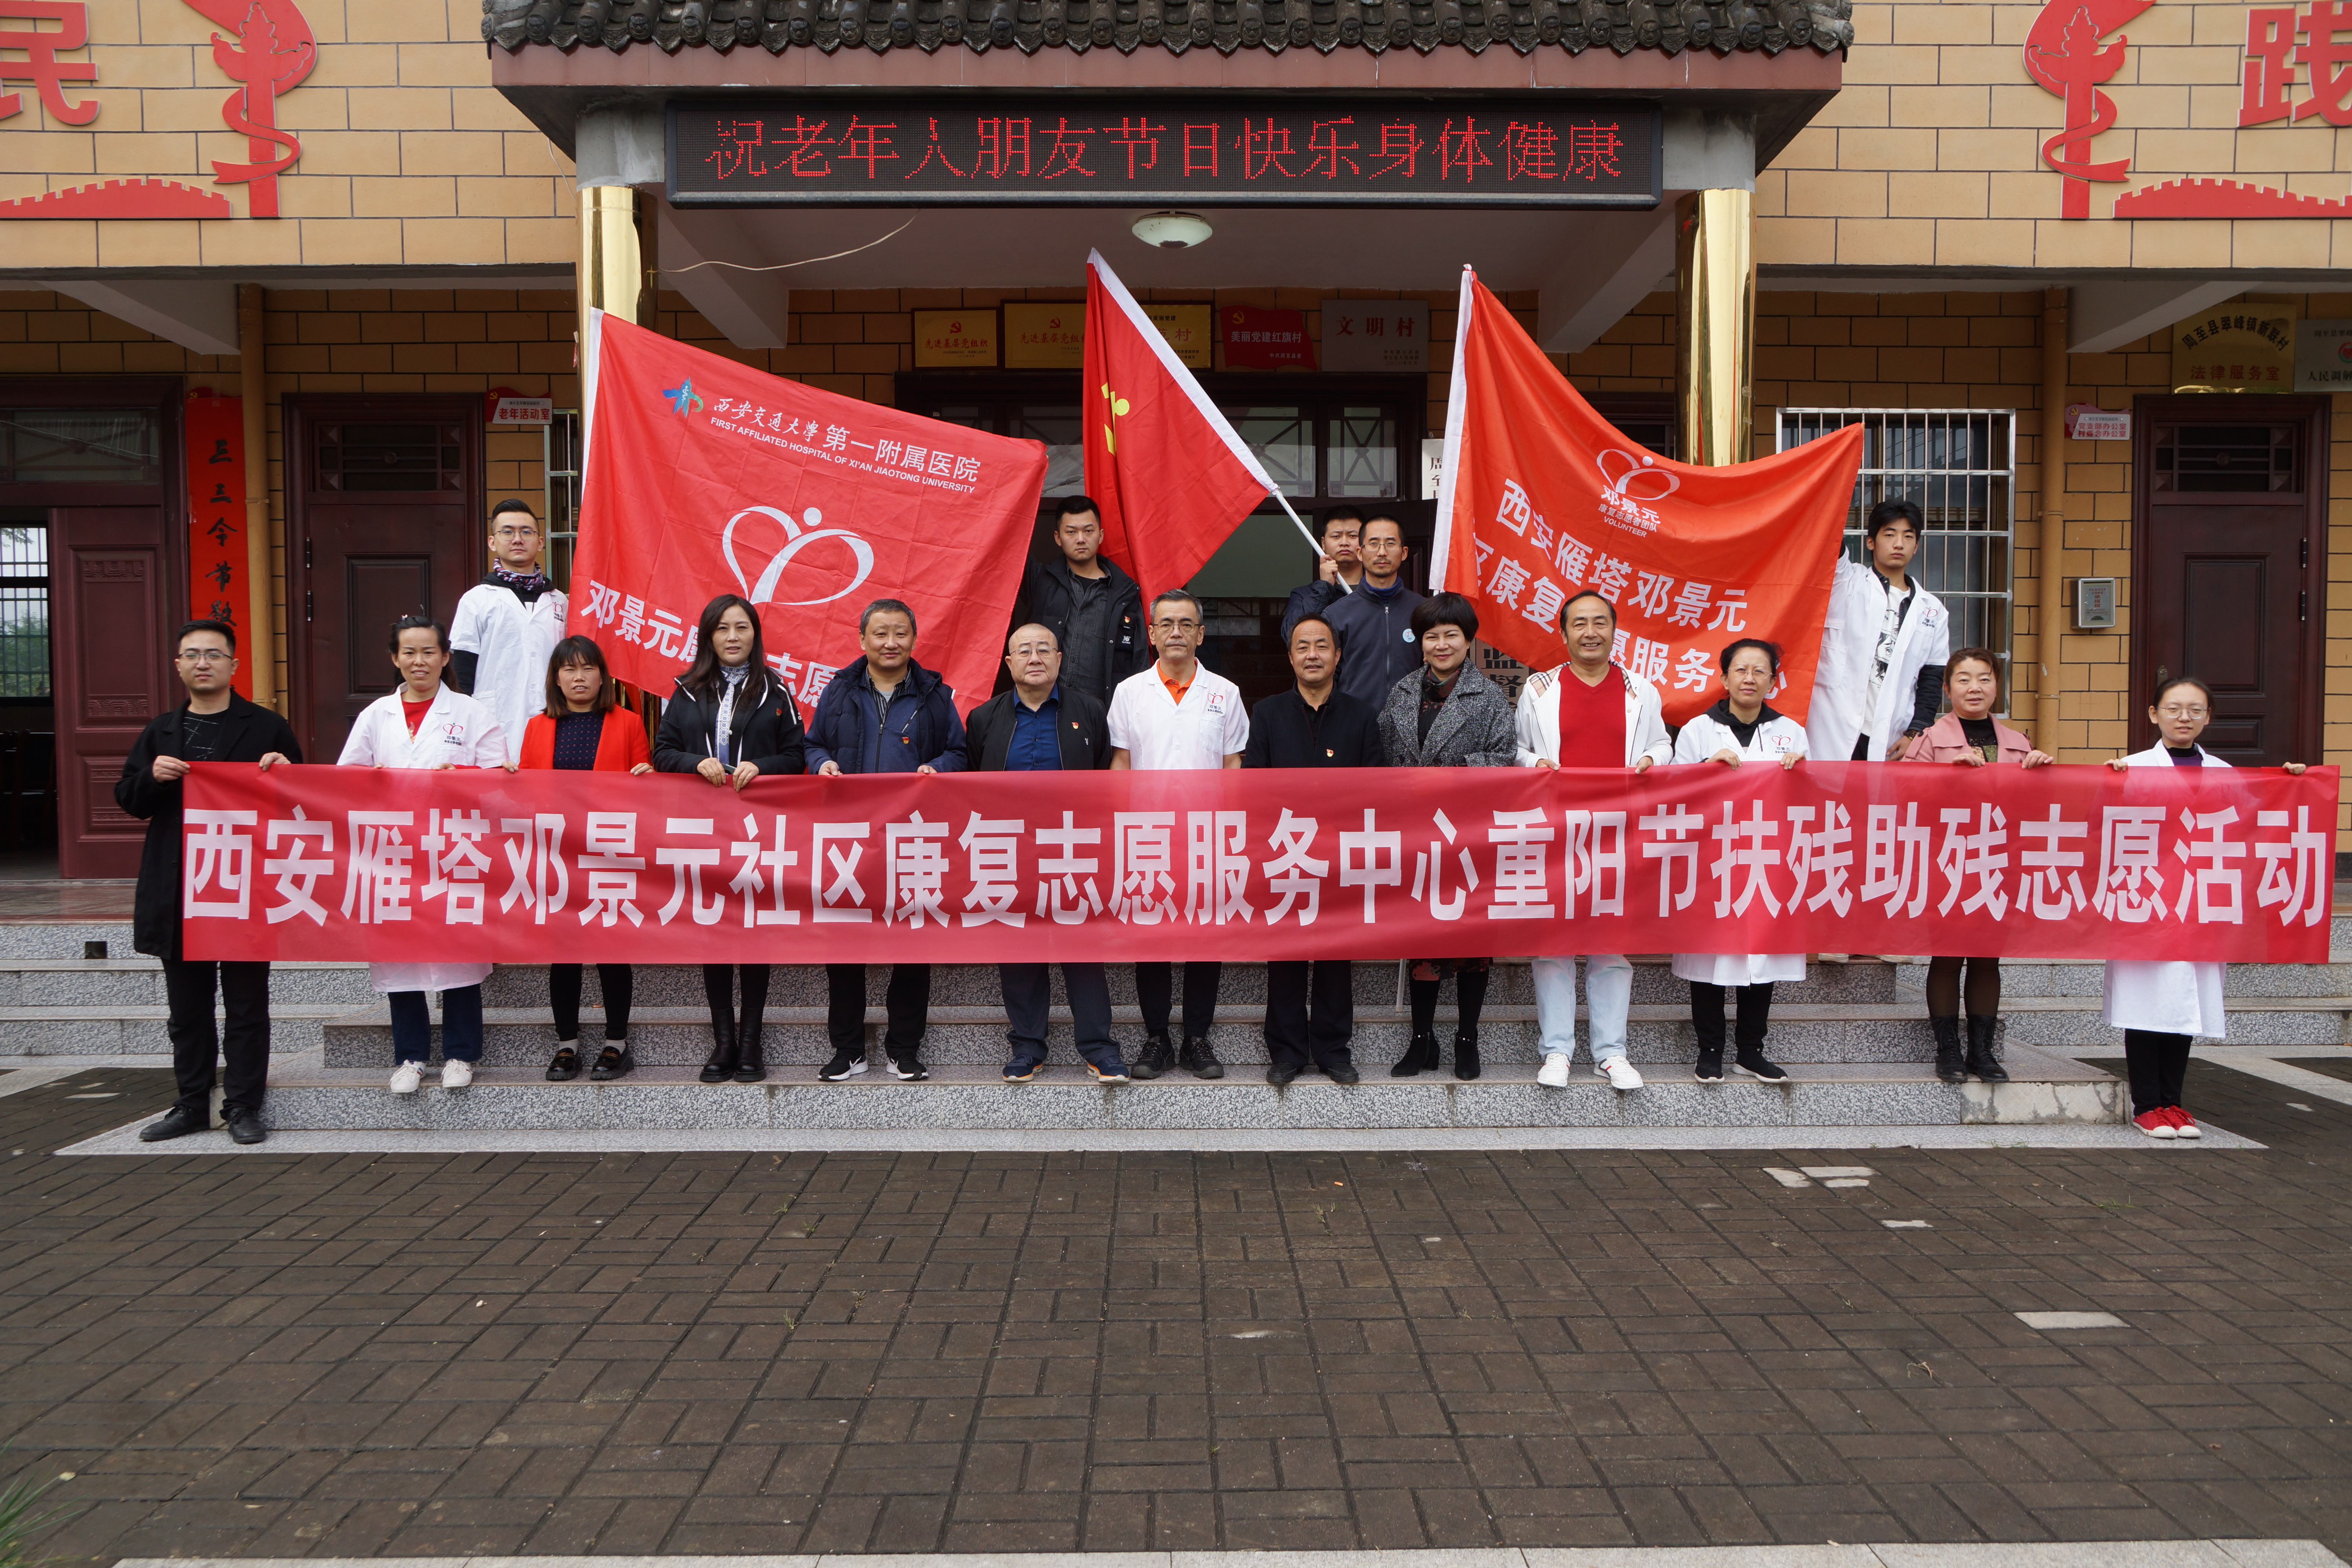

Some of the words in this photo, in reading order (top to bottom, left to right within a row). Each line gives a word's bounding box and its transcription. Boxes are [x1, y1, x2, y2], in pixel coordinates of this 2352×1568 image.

[705, 115, 1624, 182] 祝老年人朋友节日快乐身体健康
[925, 337, 988, 349] 先进基层党组织
[1231, 331, 1302, 343] 美丽党建红旗村
[1336, 316, 1415, 337] 文明村
[2181, 315, 2289, 351] 周至县翠峰镇新联村
[2190, 364, 2280, 381] 法律服务室
[499, 408, 550, 420] 老年活动室
[711, 417, 737, 433] FIRST
[737, 426, 788, 448] AFFILIATED
[789, 441, 832, 462] HOSPITAL
[835, 455, 848, 465] OF
[873, 465, 920, 483] JIAOTONG
[922, 477, 976, 494] UNIVERSITY
[822, 424, 981, 482] 第一附属医院
[1598, 503, 1657, 533] 康复志愿者团队
[1601, 485, 1661, 524] 邓景元
[1604, 516, 1647, 537] VOLUNTEER
[1495, 478, 1748, 633] 西安雁塔邓景元
[183, 800, 2327, 929] 西安雁塔邓景元社区康复志愿服务中心重阳节扶残助残志愿活动
